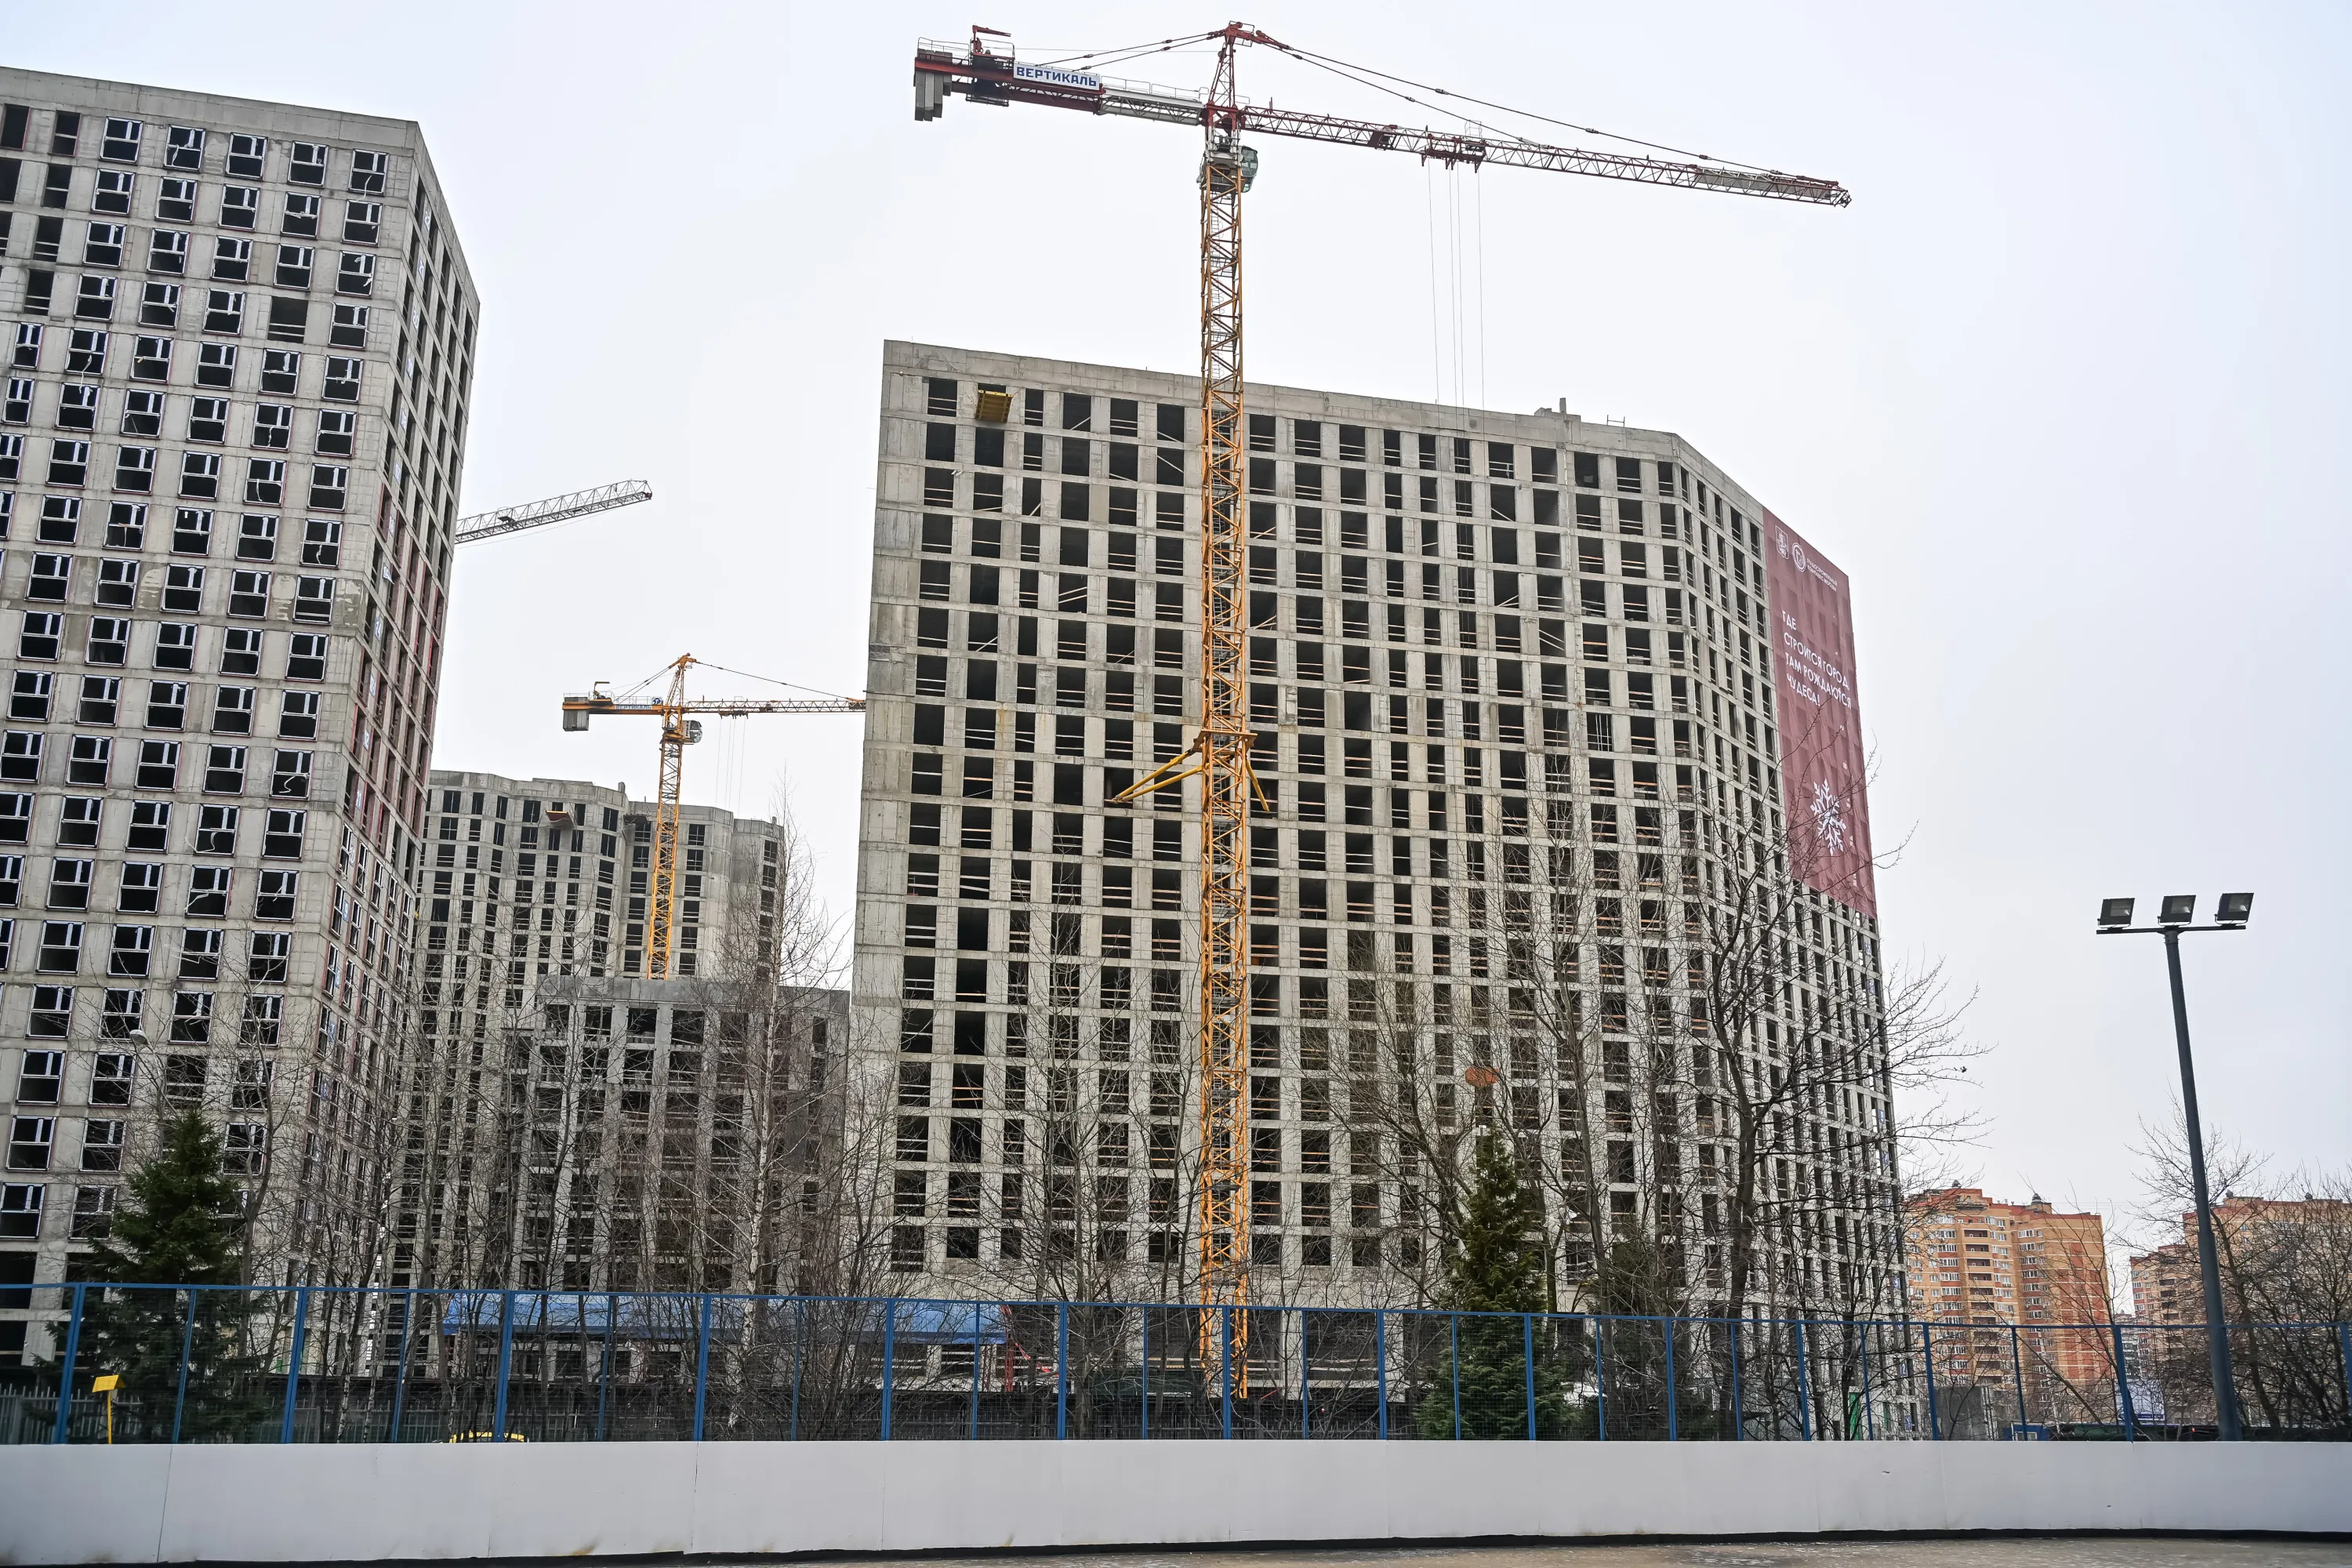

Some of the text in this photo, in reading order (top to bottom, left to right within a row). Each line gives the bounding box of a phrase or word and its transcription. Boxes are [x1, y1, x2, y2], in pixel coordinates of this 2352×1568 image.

[1016, 66, 1097, 87] ВЕРТИКАЛЬ
[1783, 611, 1797, 630] ГДЕ
[1784, 632, 1822, 669] СТРОИТСЯ
[1785, 652, 1851, 710] ТАМ РОЖДАЮТСЯ
[1787, 673, 1820, 706] ЧУДЕСА!
